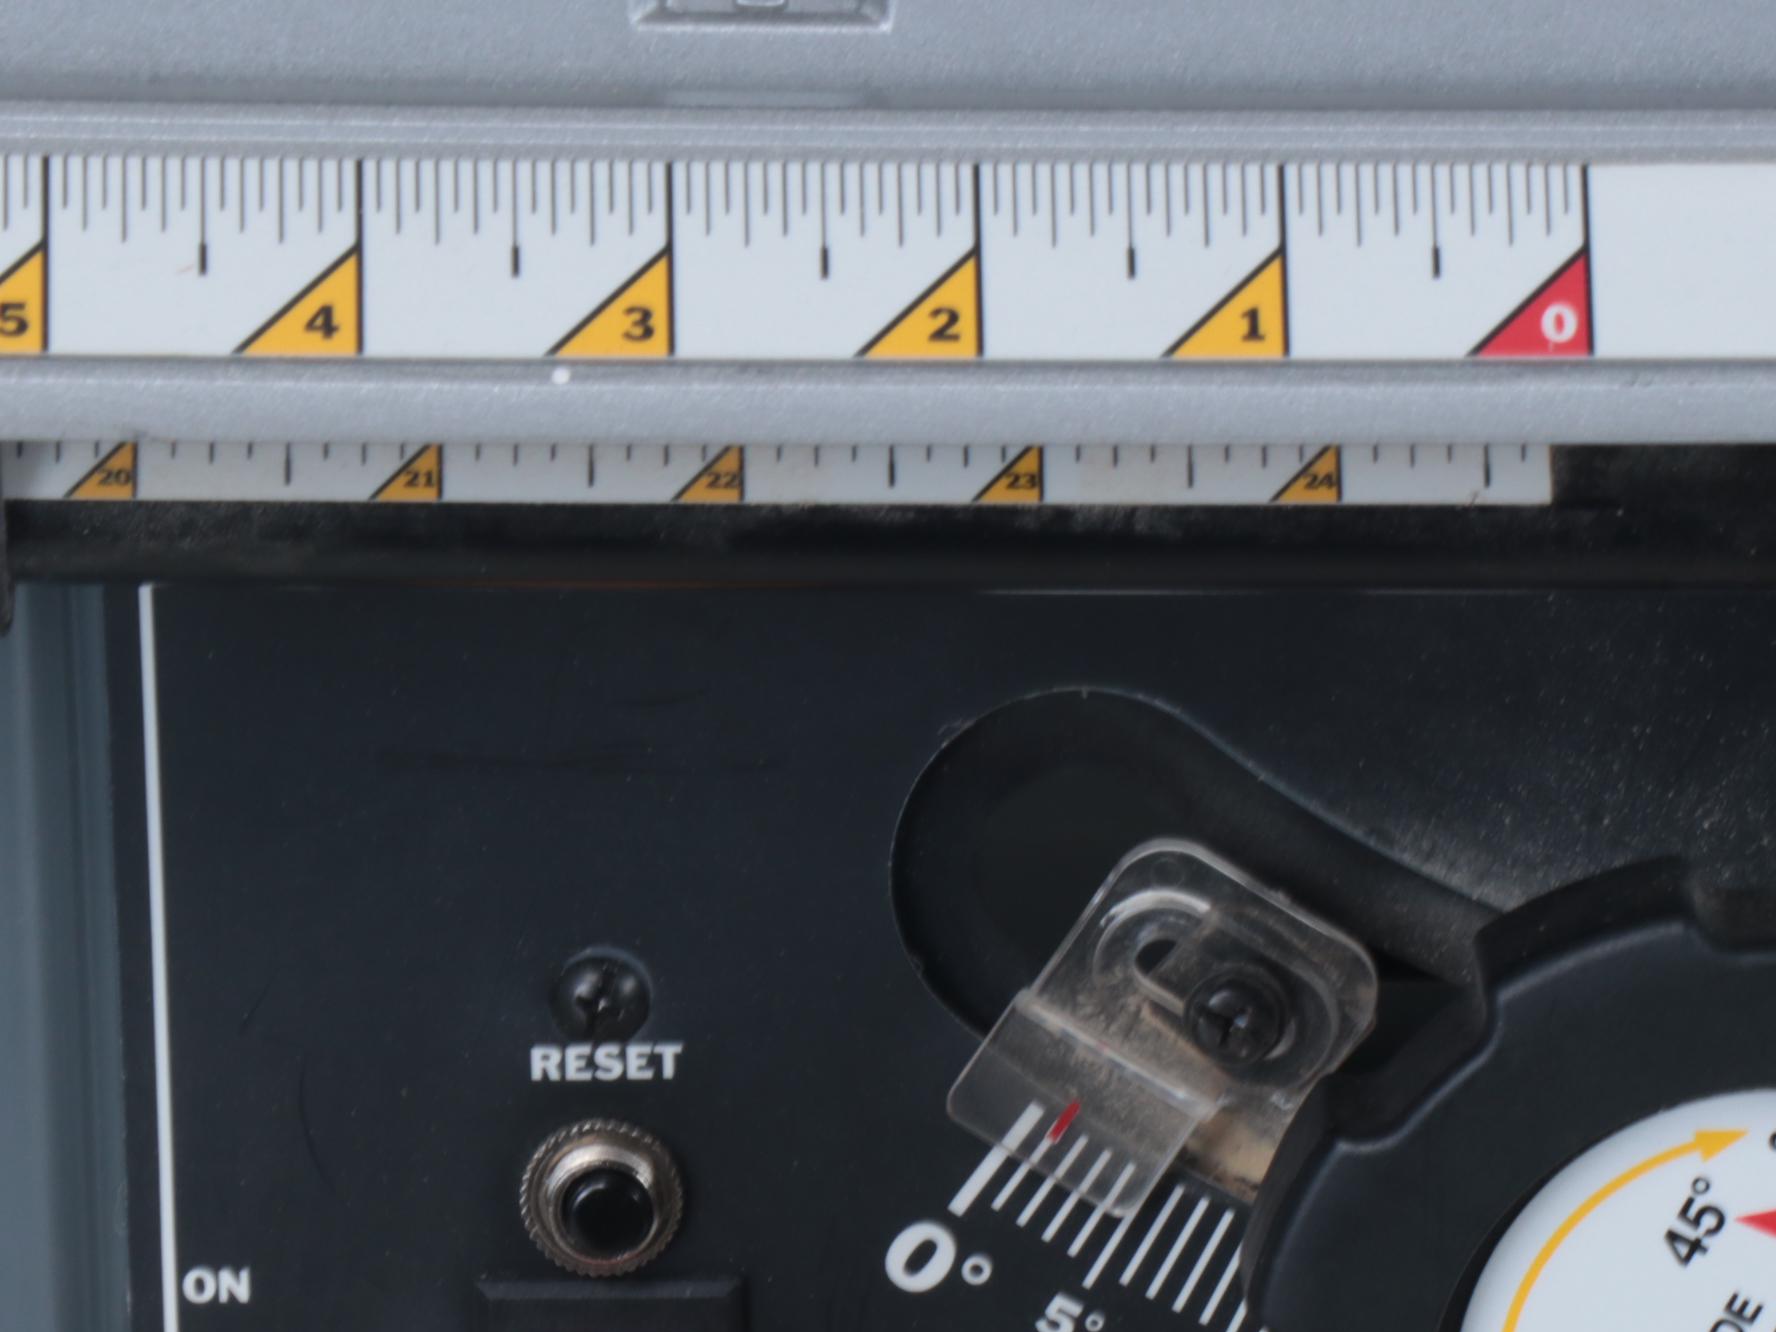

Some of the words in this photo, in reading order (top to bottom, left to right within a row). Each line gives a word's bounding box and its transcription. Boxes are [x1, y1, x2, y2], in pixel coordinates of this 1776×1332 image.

[0, 303, 28, 336] 5
[306, 305, 338, 338] 4
[626, 307, 654, 340] 3
[930, 308, 959, 341] 2
[1245, 308, 1264, 340] 1
[1542, 304, 1577, 342] 0
[96, 466, 131, 484] 20
[402, 466, 434, 486] 21
[705, 467, 738, 488] 22
[1004, 468, 1038, 488] 23
[1301, 470, 1335, 488] 24
[531, 1044, 682, 1080] RESET
[183, 1268, 250, 1303] ON
